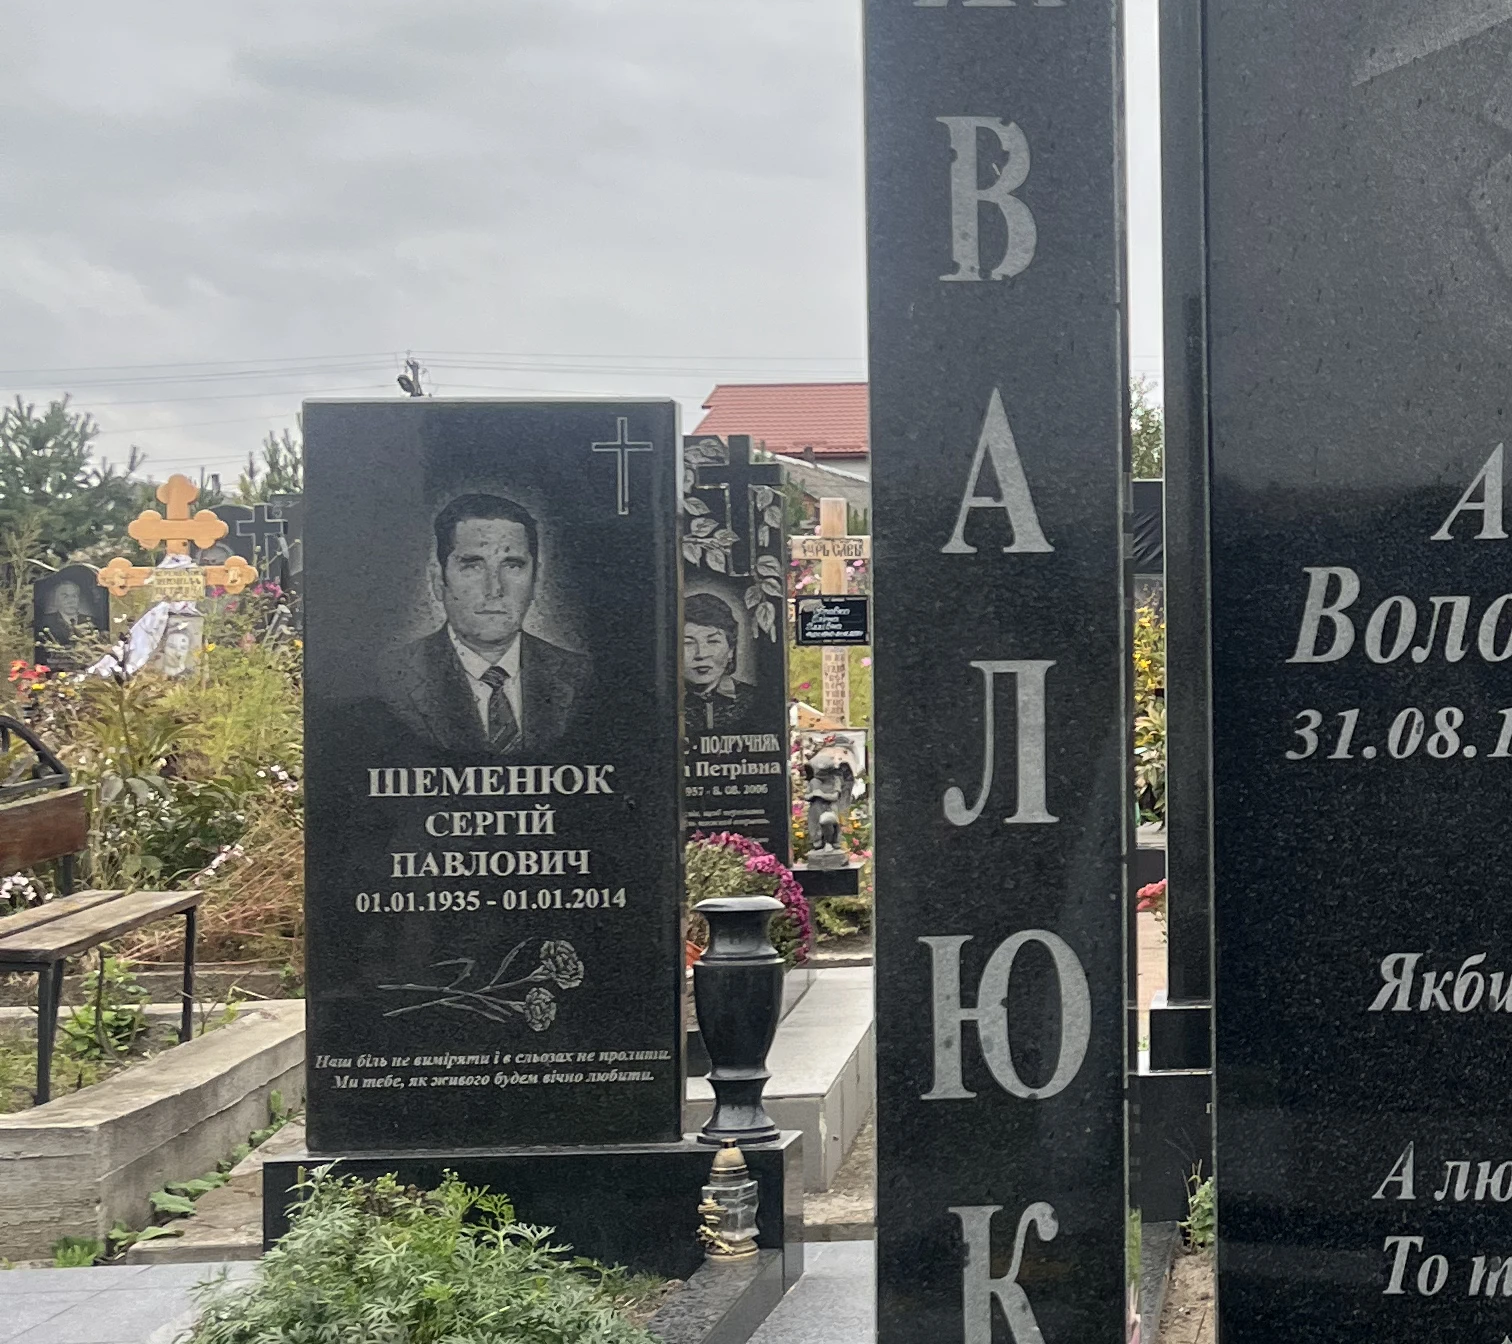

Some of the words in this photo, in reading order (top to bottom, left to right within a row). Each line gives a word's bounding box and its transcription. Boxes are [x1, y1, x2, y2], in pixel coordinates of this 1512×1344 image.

[700, 734, 780, 754] ПОДРУЧНЯК
[366, 763, 616, 798] ШЕМЕНЮК
[696, 759, 781, 780] Петрівна
[424, 802, 557, 838] СЕРГІЙ
[390, 849, 591, 878] ПАВЛОВИЧ
[355, 890, 481, 913] 01.01.1935
[502, 887, 627, 910] 01.01.2014
[315, 1054, 353, 1069] Наш
[356, 1053, 388, 1068] біль
[391, 1056, 411, 1067] не
[413, 1051, 491, 1069] виміряти
[493, 1050, 501, 1065] і
[502, 1054, 512, 1064] в
[514, 1052, 575, 1064] сльозах
[576, 1051, 596, 1062] не
[334, 1075, 359, 1089] Ми
[361, 1074, 405, 1090] тебе,
[407, 1076, 429, 1087] як
[430, 1074, 491, 1087] живого
[493, 1070, 539, 1089] будем
[542, 1069, 584, 1084] вічно
[585, 1068, 655, 1083] любити.
[1371, 1140, 1416, 1200] А
[1381, 1234, 1450, 1297] То
